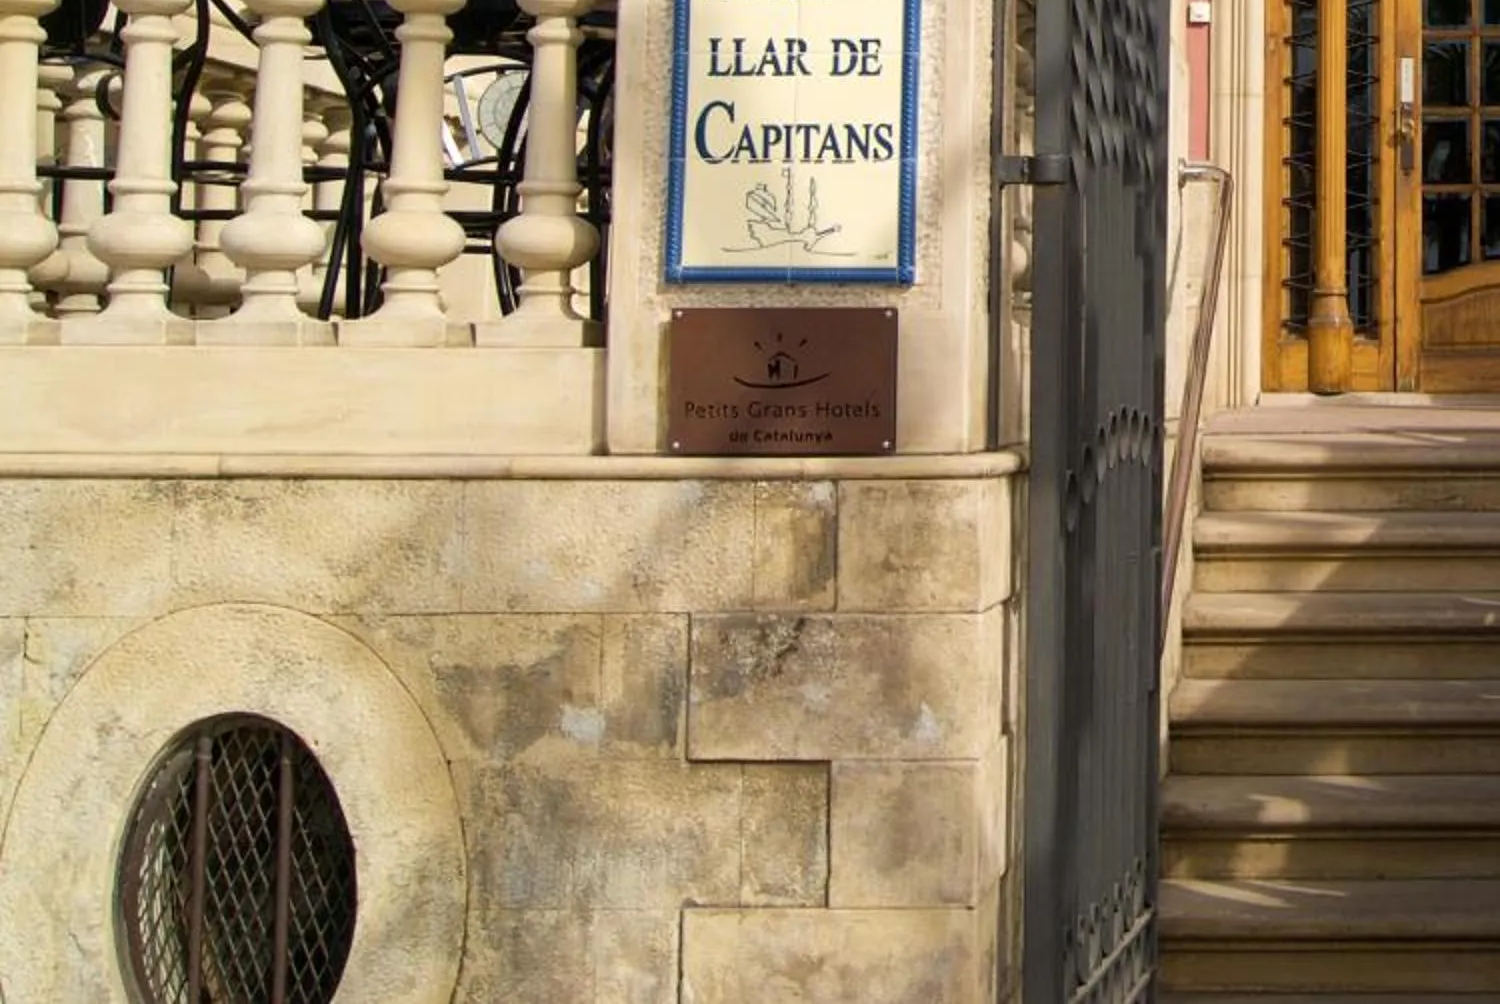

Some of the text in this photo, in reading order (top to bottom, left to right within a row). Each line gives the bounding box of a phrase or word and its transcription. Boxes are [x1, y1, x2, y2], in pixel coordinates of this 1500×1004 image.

[707, 37, 883, 77] LLAR DE
[694, 100, 894, 165] CAPITANS
[684, 400, 881, 419] Petits Grans Hotels
[753, 428, 833, 444] Catalunya
